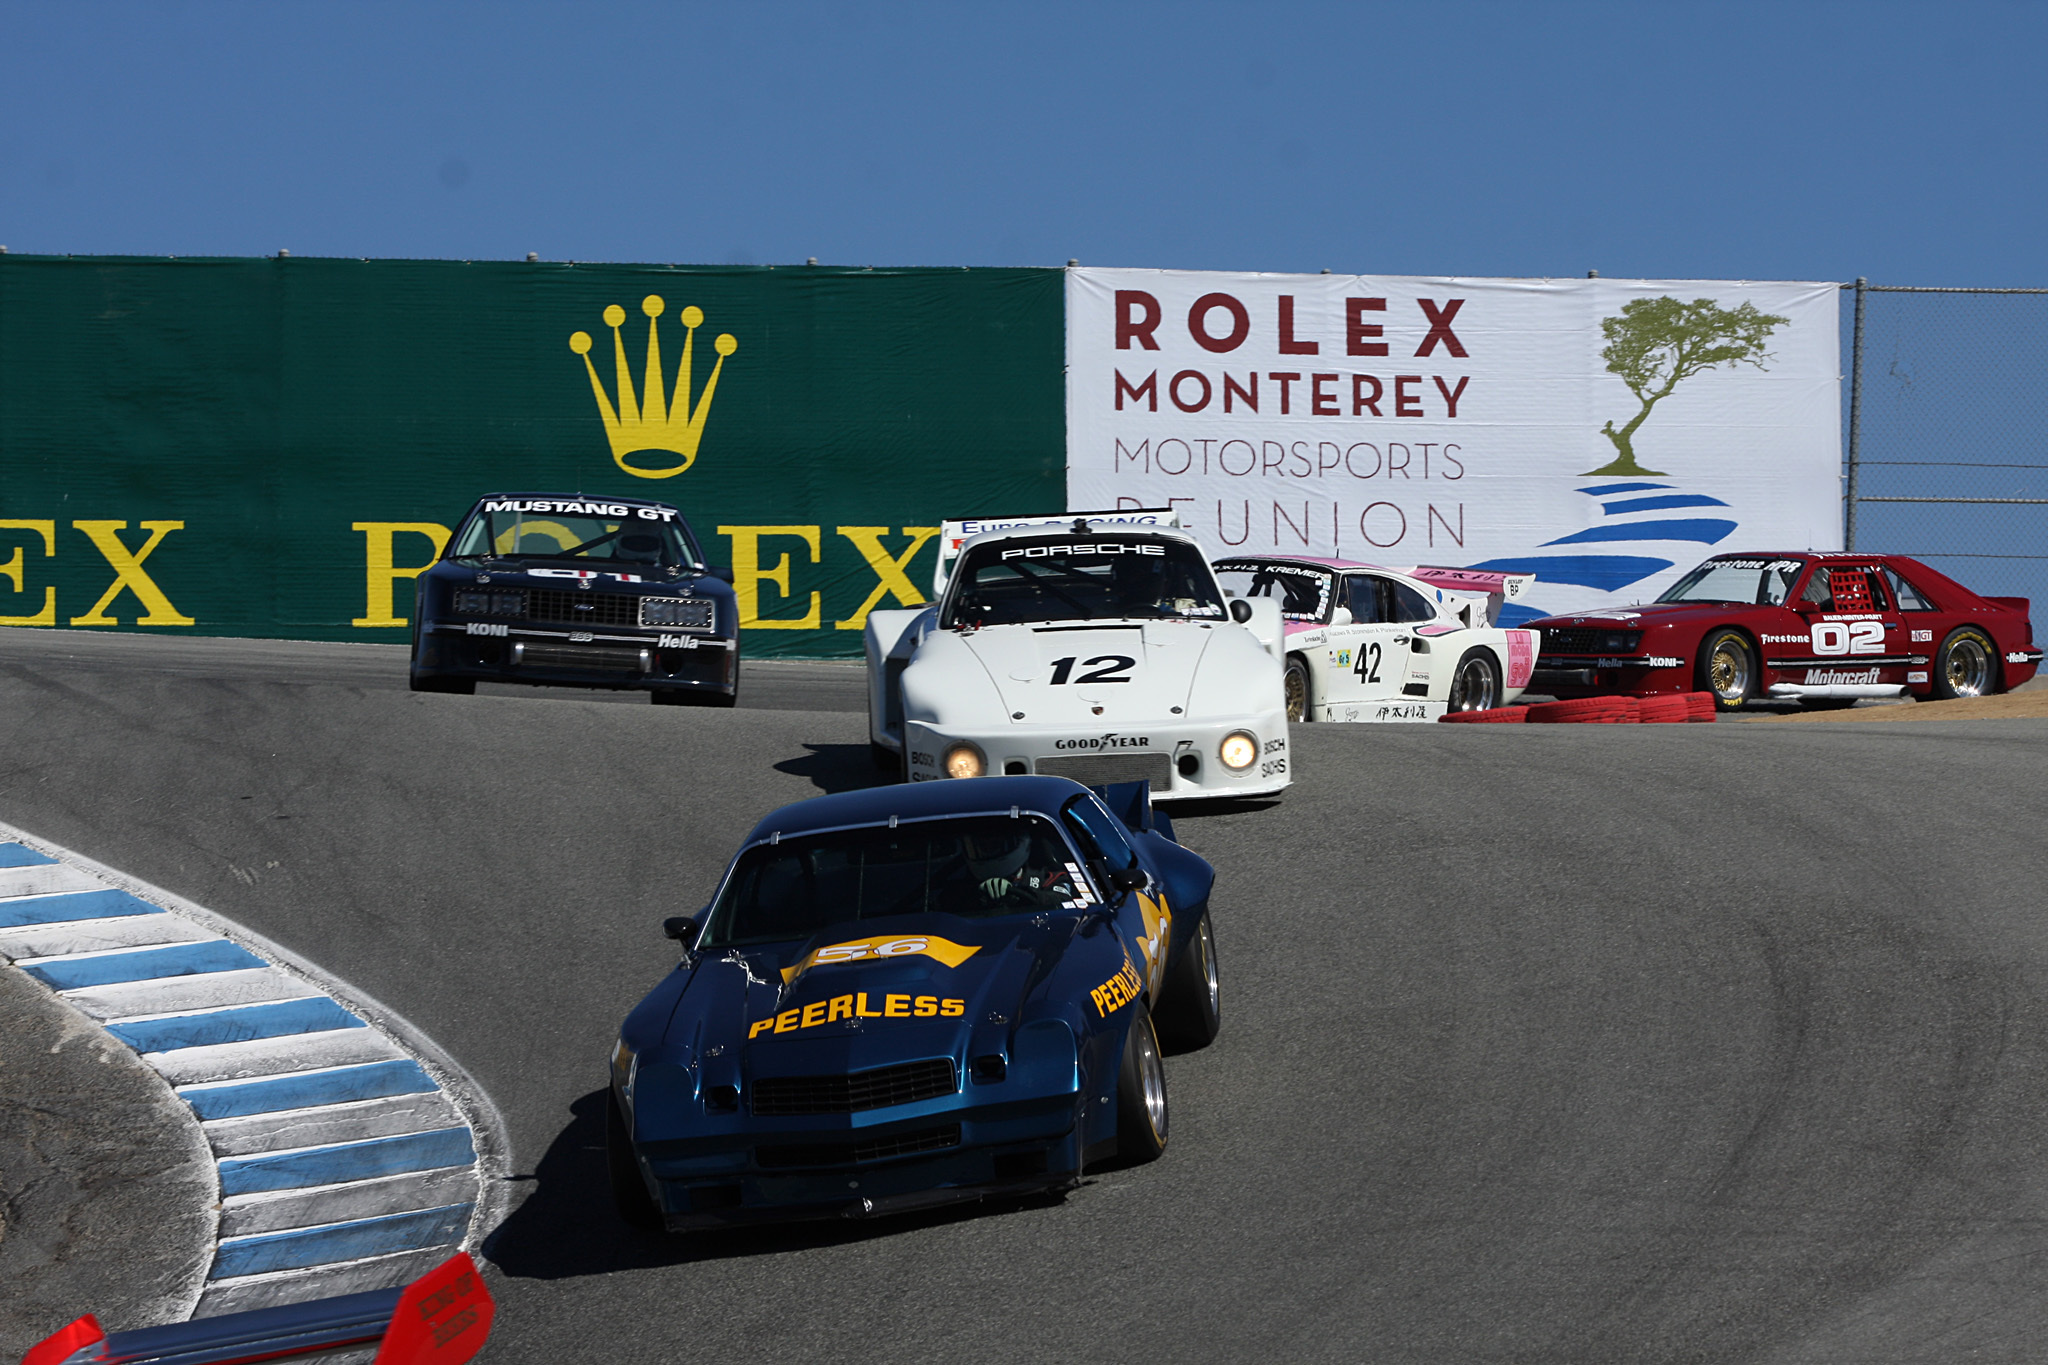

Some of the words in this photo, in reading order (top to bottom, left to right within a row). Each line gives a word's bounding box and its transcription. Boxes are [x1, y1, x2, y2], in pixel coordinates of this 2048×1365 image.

[1115, 290, 1470, 357] ROLEX
[1115, 368, 1470, 418] MONTEREY
[1115, 438, 1464, 480] MOTORSPORTS
[485, 501, 629, 516] MUSTANG
[638, 508, 676, 522] GT
[1117, 497, 1464, 548] UNION
[1002, 544, 1165, 560] PORSCHE
[1510, 585, 1519, 596] BP
[467, 623, 508, 636] KONI
[1760, 634, 1810, 645] Firestone
[1811, 621, 1886, 655] 02
[659, 635, 699, 649] Hella
[1354, 642, 1382, 684] 42
[1650, 657, 1677, 667] KONI
[2009, 652, 2028, 663] Hella
[1049, 655, 1136, 685] 12
[1804, 668, 1881, 684] Motorcraft
[1264, 738, 1285, 755] BOSCH
[1262, 758, 1286, 778] SACHS
[813, 937, 930, 963] 56
[748, 992, 965, 1039] PEERLESS
